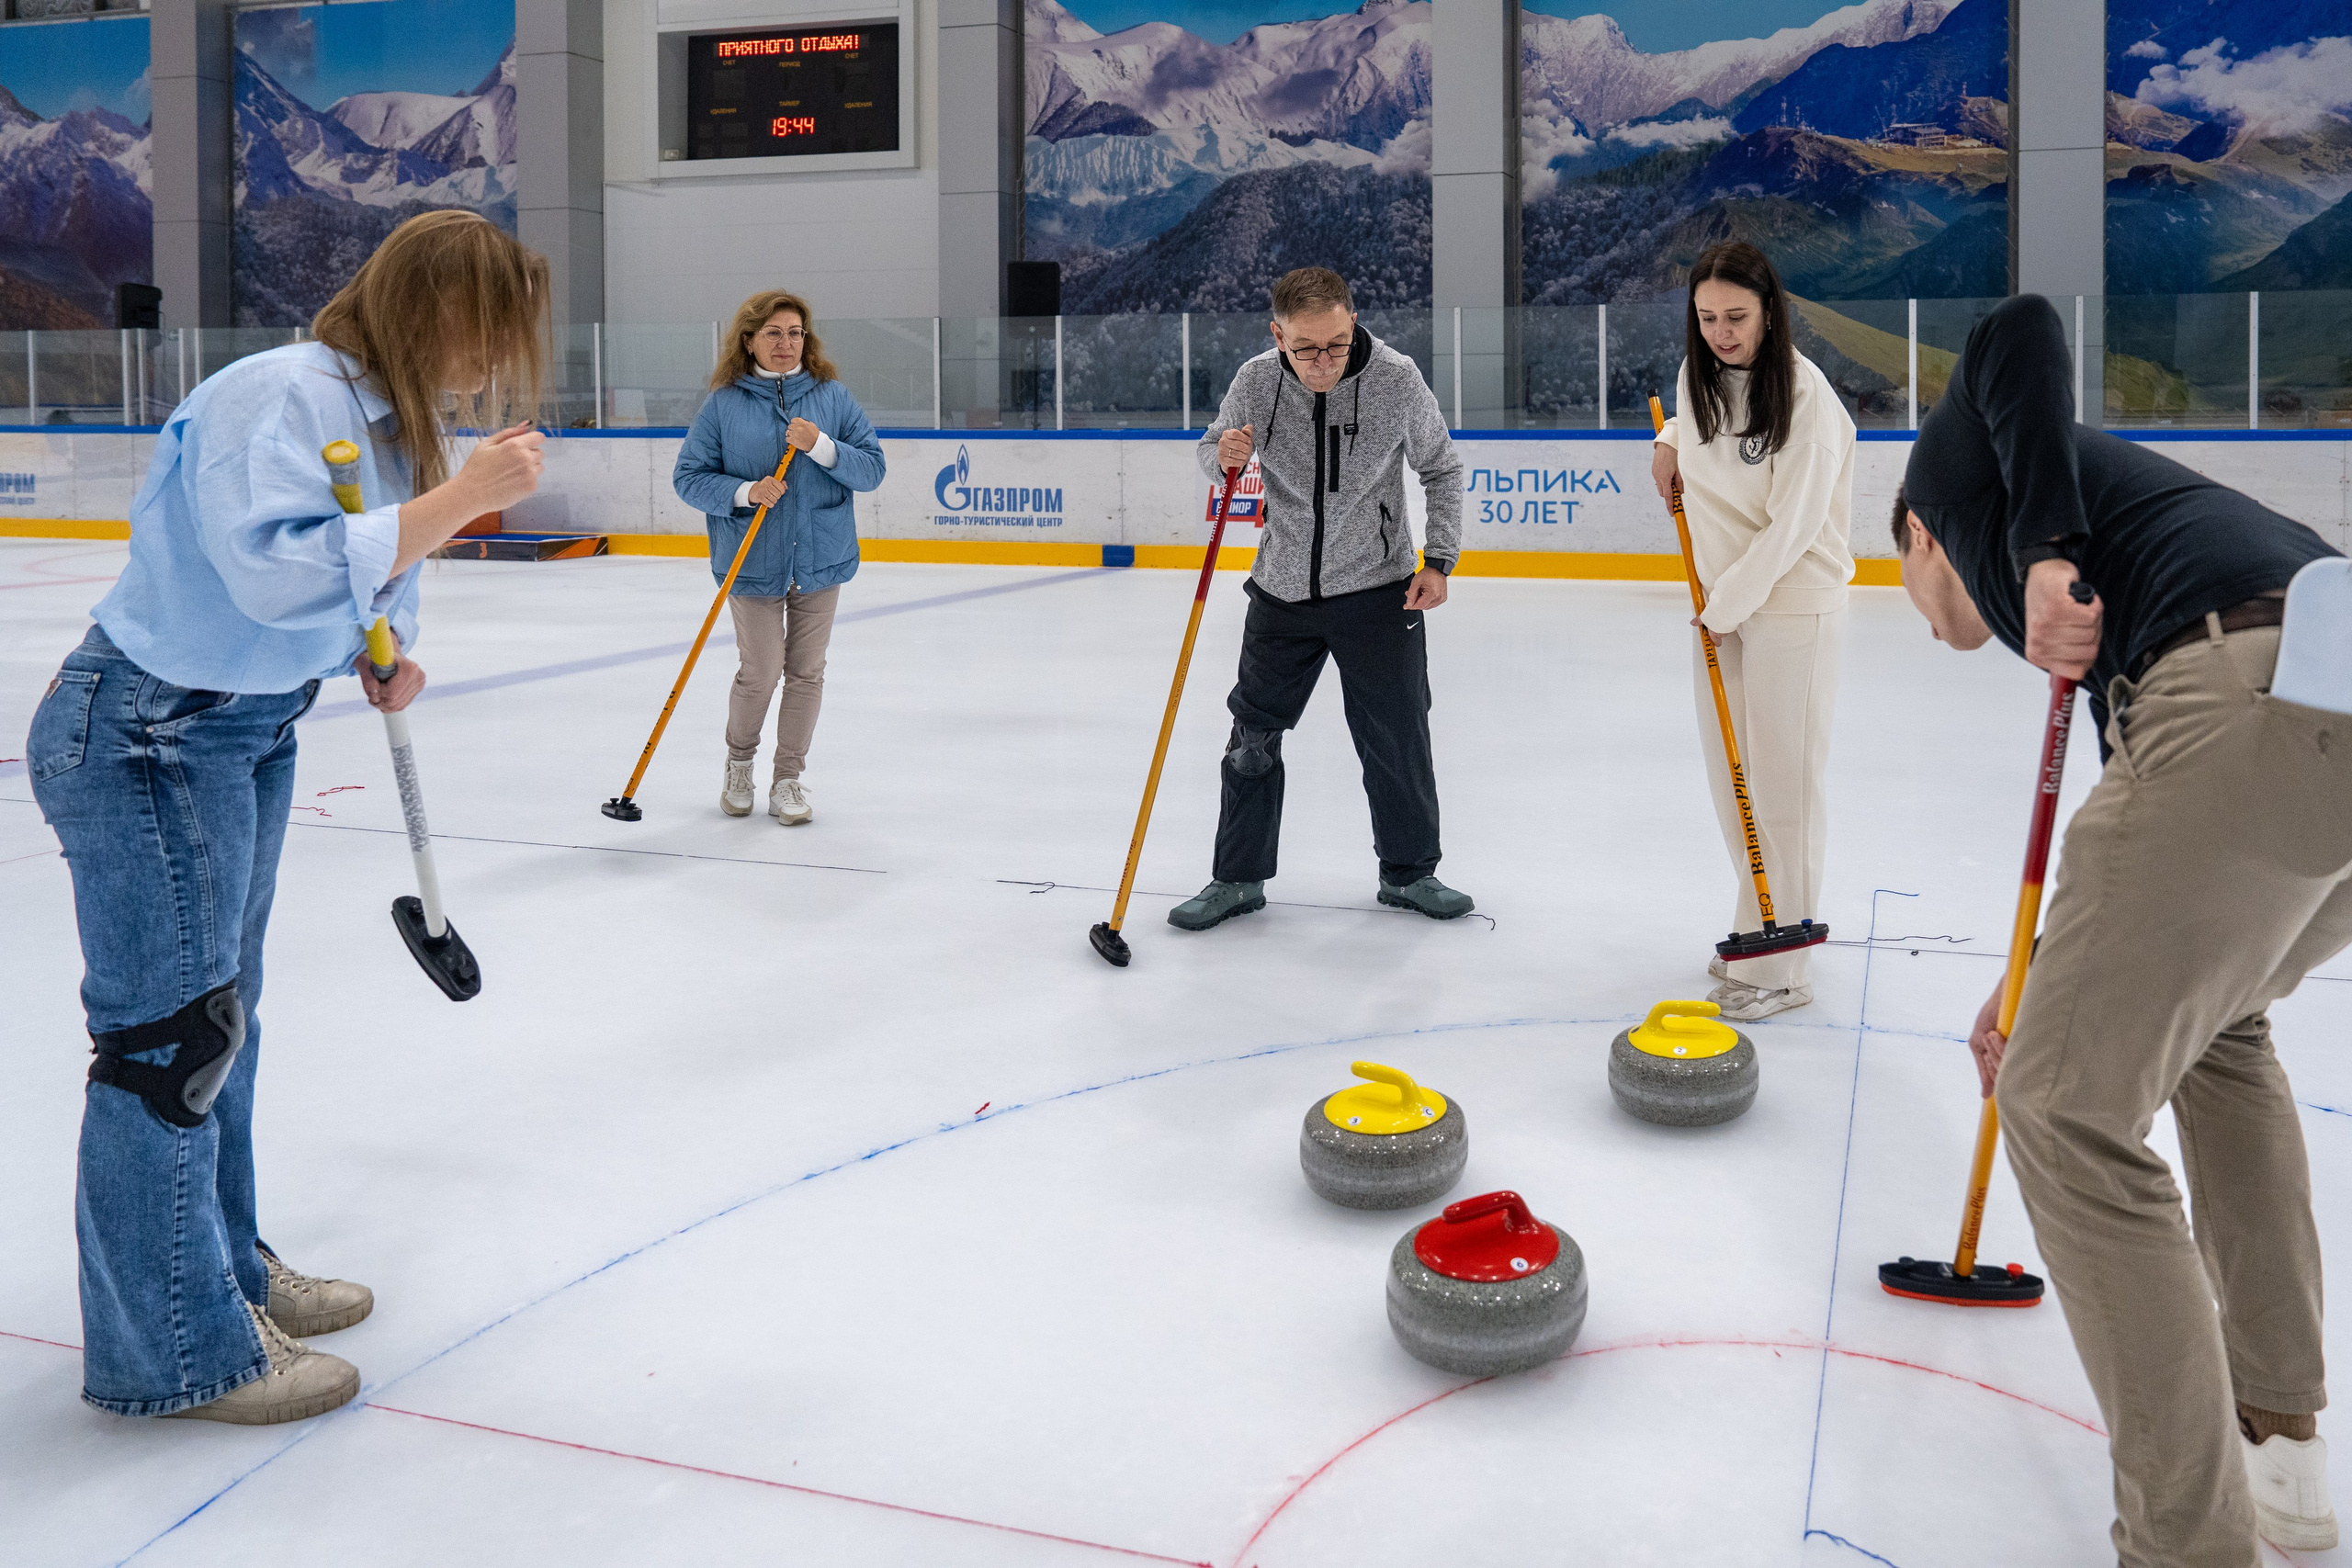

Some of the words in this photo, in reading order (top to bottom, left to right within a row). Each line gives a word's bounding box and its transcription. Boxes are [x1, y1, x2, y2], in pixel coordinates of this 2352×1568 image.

[718, 38, 794, 57] ПРИЯТНОГО
[801, 34, 860, 51] ОТДЫХА!
[772, 117, 815, 137] 19:44
[1463, 468, 1621, 493] ЛЬПИКА
[934, 514, 1034, 526] ГОРНО-ТУРИСТИЧЕСКИЙ
[1036, 517, 1063, 528] ЦЕНТР
[1479, 500, 1512, 524] 30
[1520, 501, 1580, 524] ЛЕТ
[2042, 692, 2075, 795] BalancePlus
[1733, 762, 1765, 874] BalancePlus
